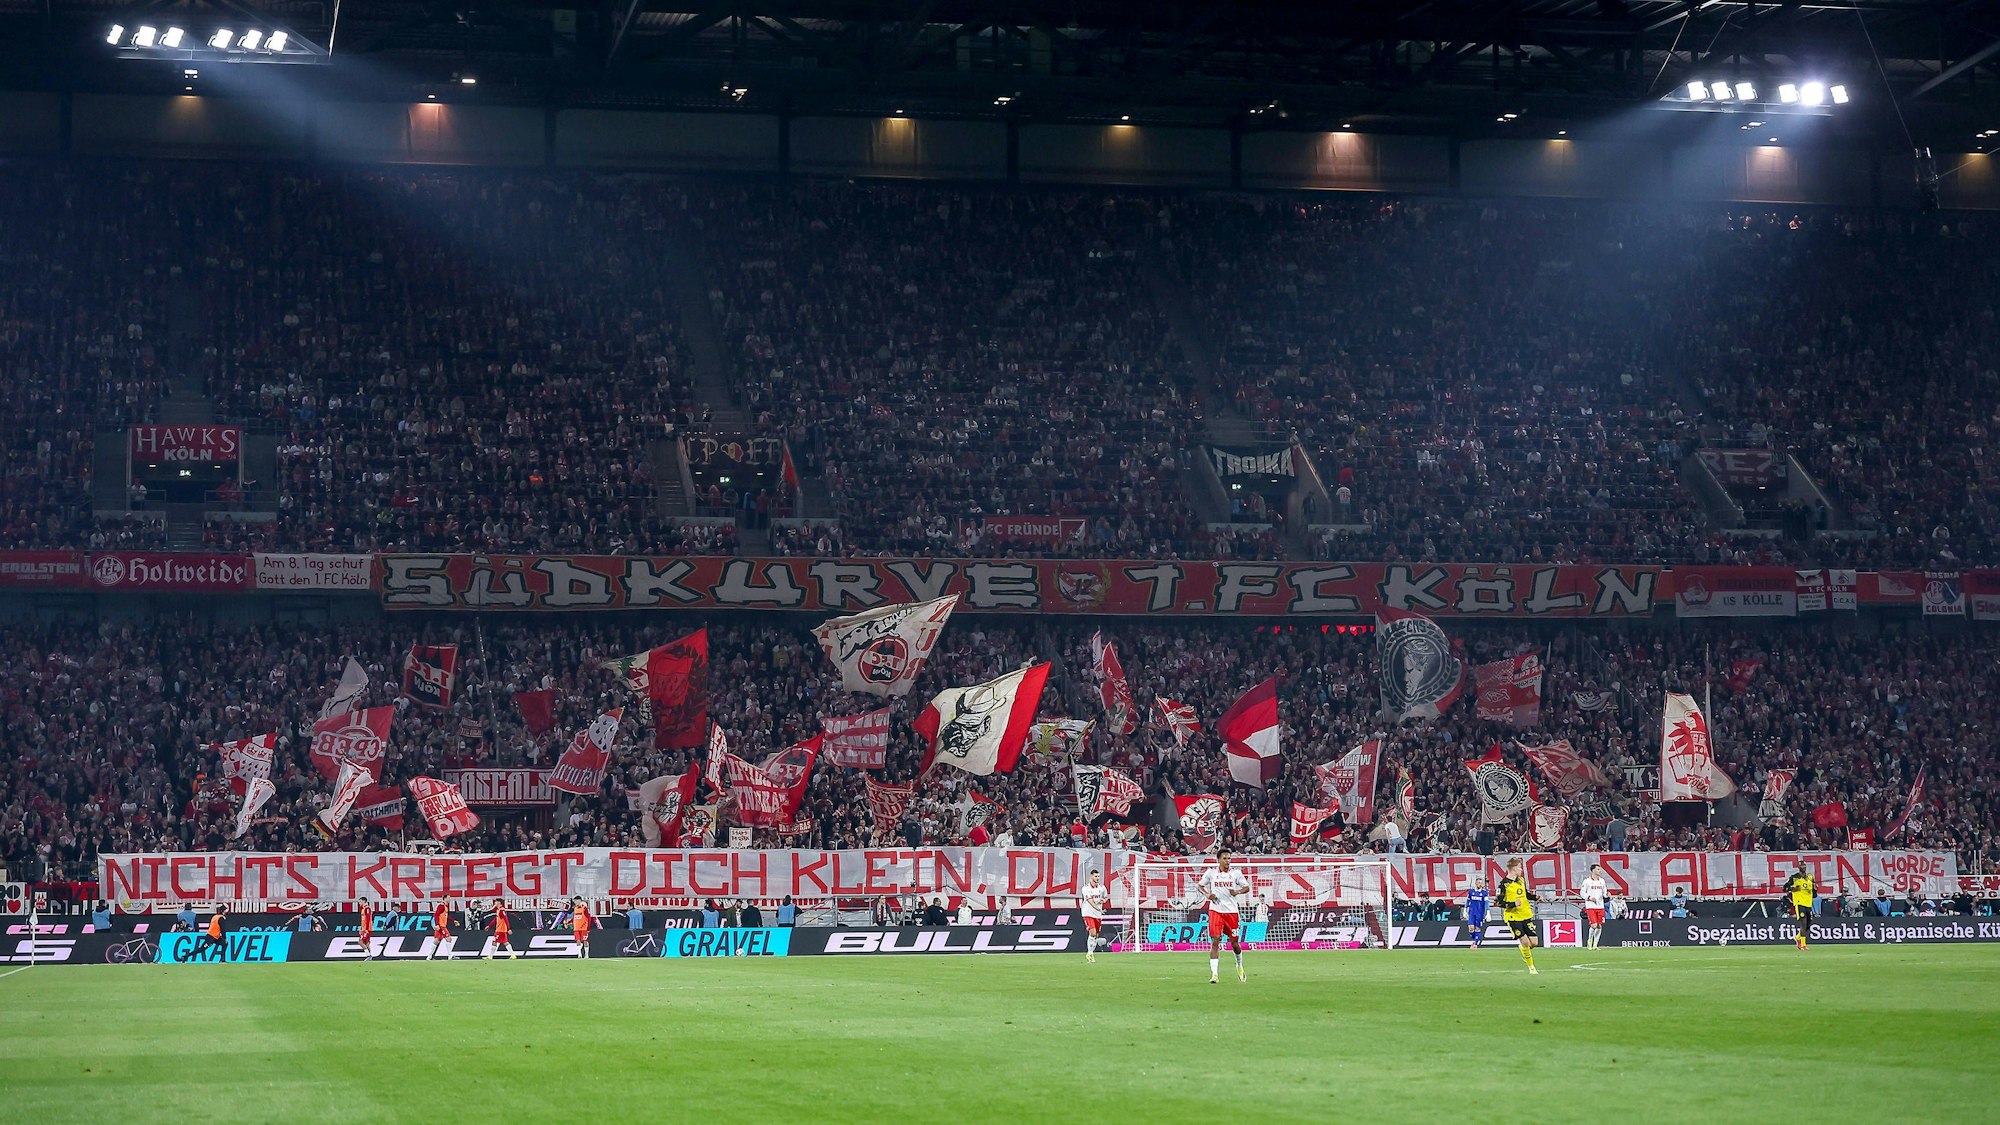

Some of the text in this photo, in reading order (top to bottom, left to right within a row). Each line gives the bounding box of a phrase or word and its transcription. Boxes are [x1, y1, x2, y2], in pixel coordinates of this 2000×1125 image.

[136, 427, 236, 453] HAWKS
[164, 445, 212, 460] KÖLN
[1212, 447, 1295, 477] TROIKA
[1007, 522, 1059, 535] FRÜNDE
[128, 557, 244, 586] Holweide
[263, 556, 364, 572] Am 8. Tag schuf
[259, 571, 368, 585] Gott den 1. FC Köln
[383, 556, 1040, 609] SÜDKURVE
[1376, 566, 1659, 617] KÖLN
[1723, 592, 1784, 606] US KÖLLE
[1926, 605, 1962, 613] COLONIA
[1623, 768, 1646, 788] TK
[692, 827, 703, 836] 12
[106, 856, 318, 900] NICHTS
[348, 852, 584, 898] KRIEGT
[609, 852, 767, 896] DICH
[792, 850, 986, 895] KLEIN,
[1006, 850, 1081, 895] DU
[1660, 852, 1870, 896] ALLEIN
[1881, 854, 1945, 877] HORDE
[679, 930, 775, 957] GRAVEL
[823, 929, 1074, 953] BULLS
[1621, 940, 1651, 948] BENTO
[1687, 924, 1775, 944] Spezialist
[1809, 922, 1860, 940] Sushi
[1863, 923, 1877, 939] &
[1879, 922, 1974, 943] japanische
[173, 935, 274, 962] GRAVEL
[325, 935, 581, 958] BULLS
